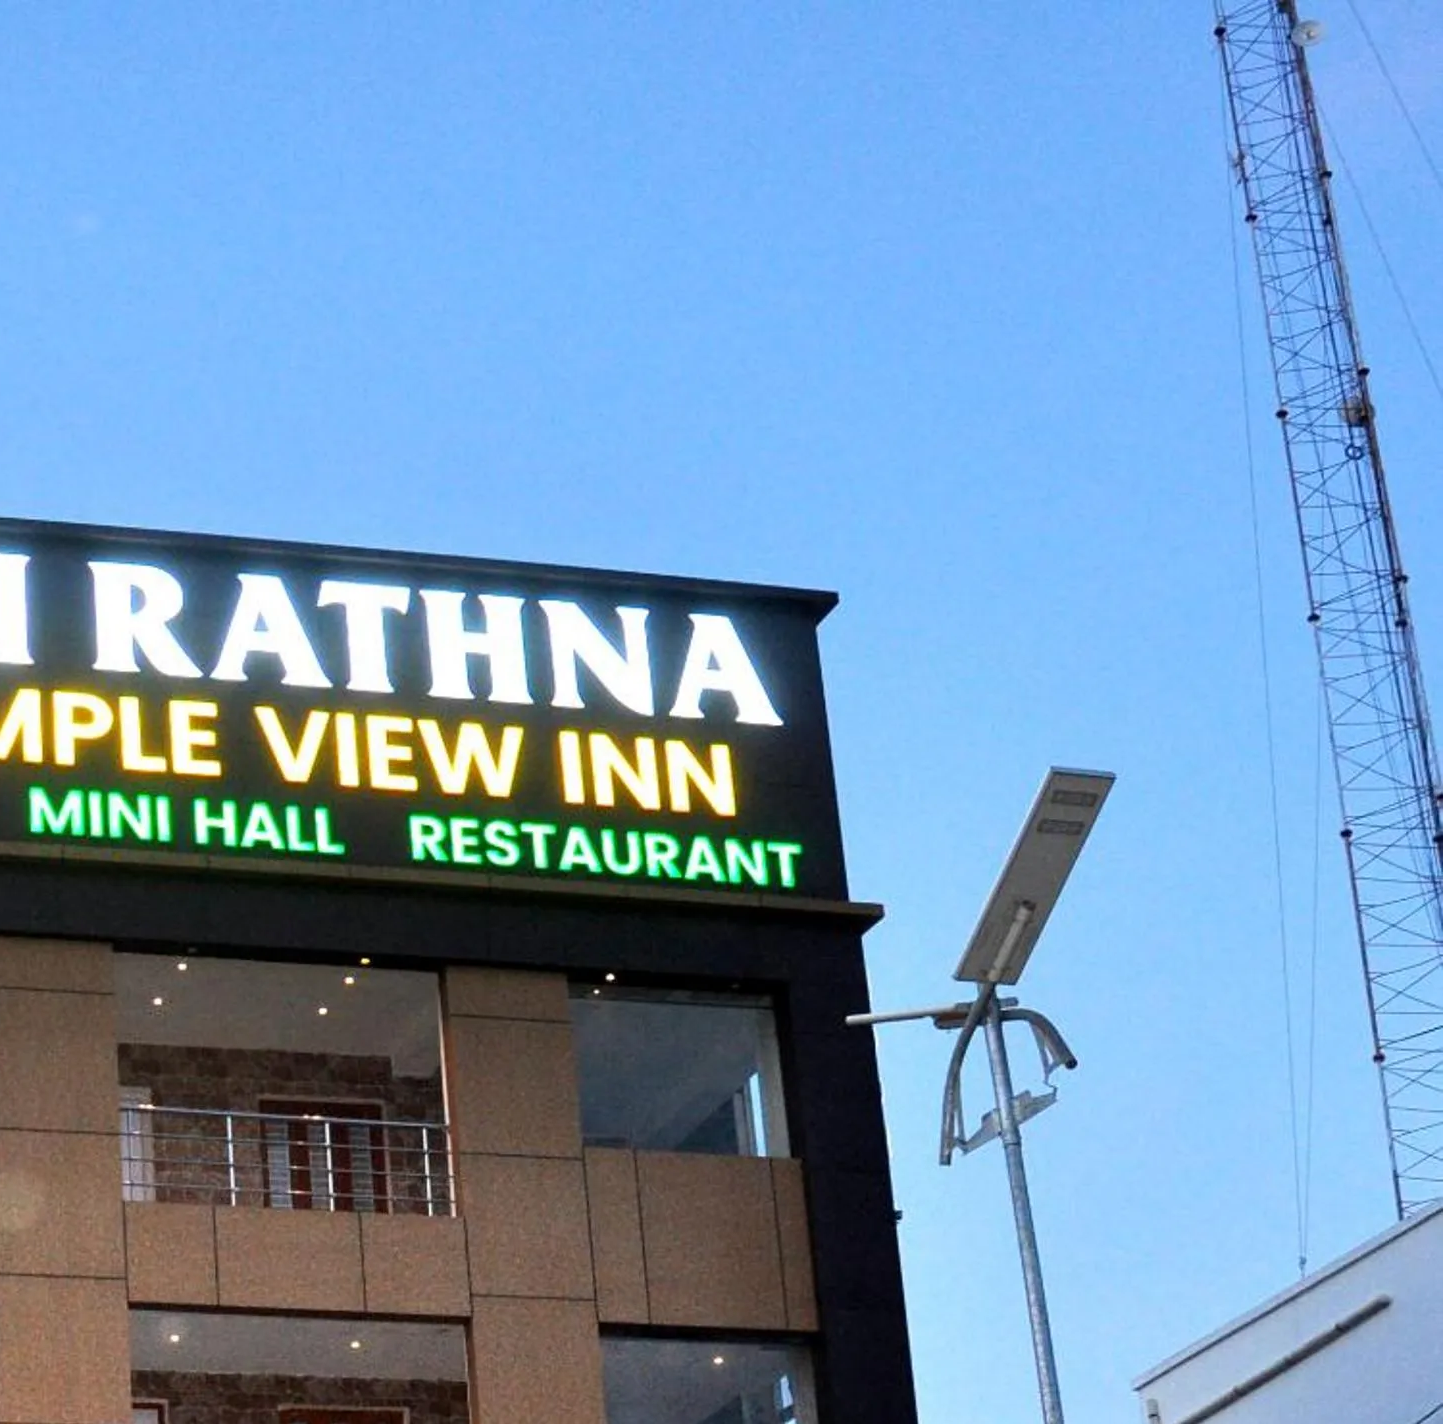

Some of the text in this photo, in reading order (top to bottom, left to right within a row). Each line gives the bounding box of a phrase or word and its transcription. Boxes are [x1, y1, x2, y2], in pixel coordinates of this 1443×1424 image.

[87, 560, 784, 727] RATHNA
[255, 706, 524, 799] VIEW
[558, 730, 737, 817] INN
[29, 787, 170, 842] MINI
[193, 799, 345, 855] HALL
[409, 815, 802, 888] RESTAURANT
